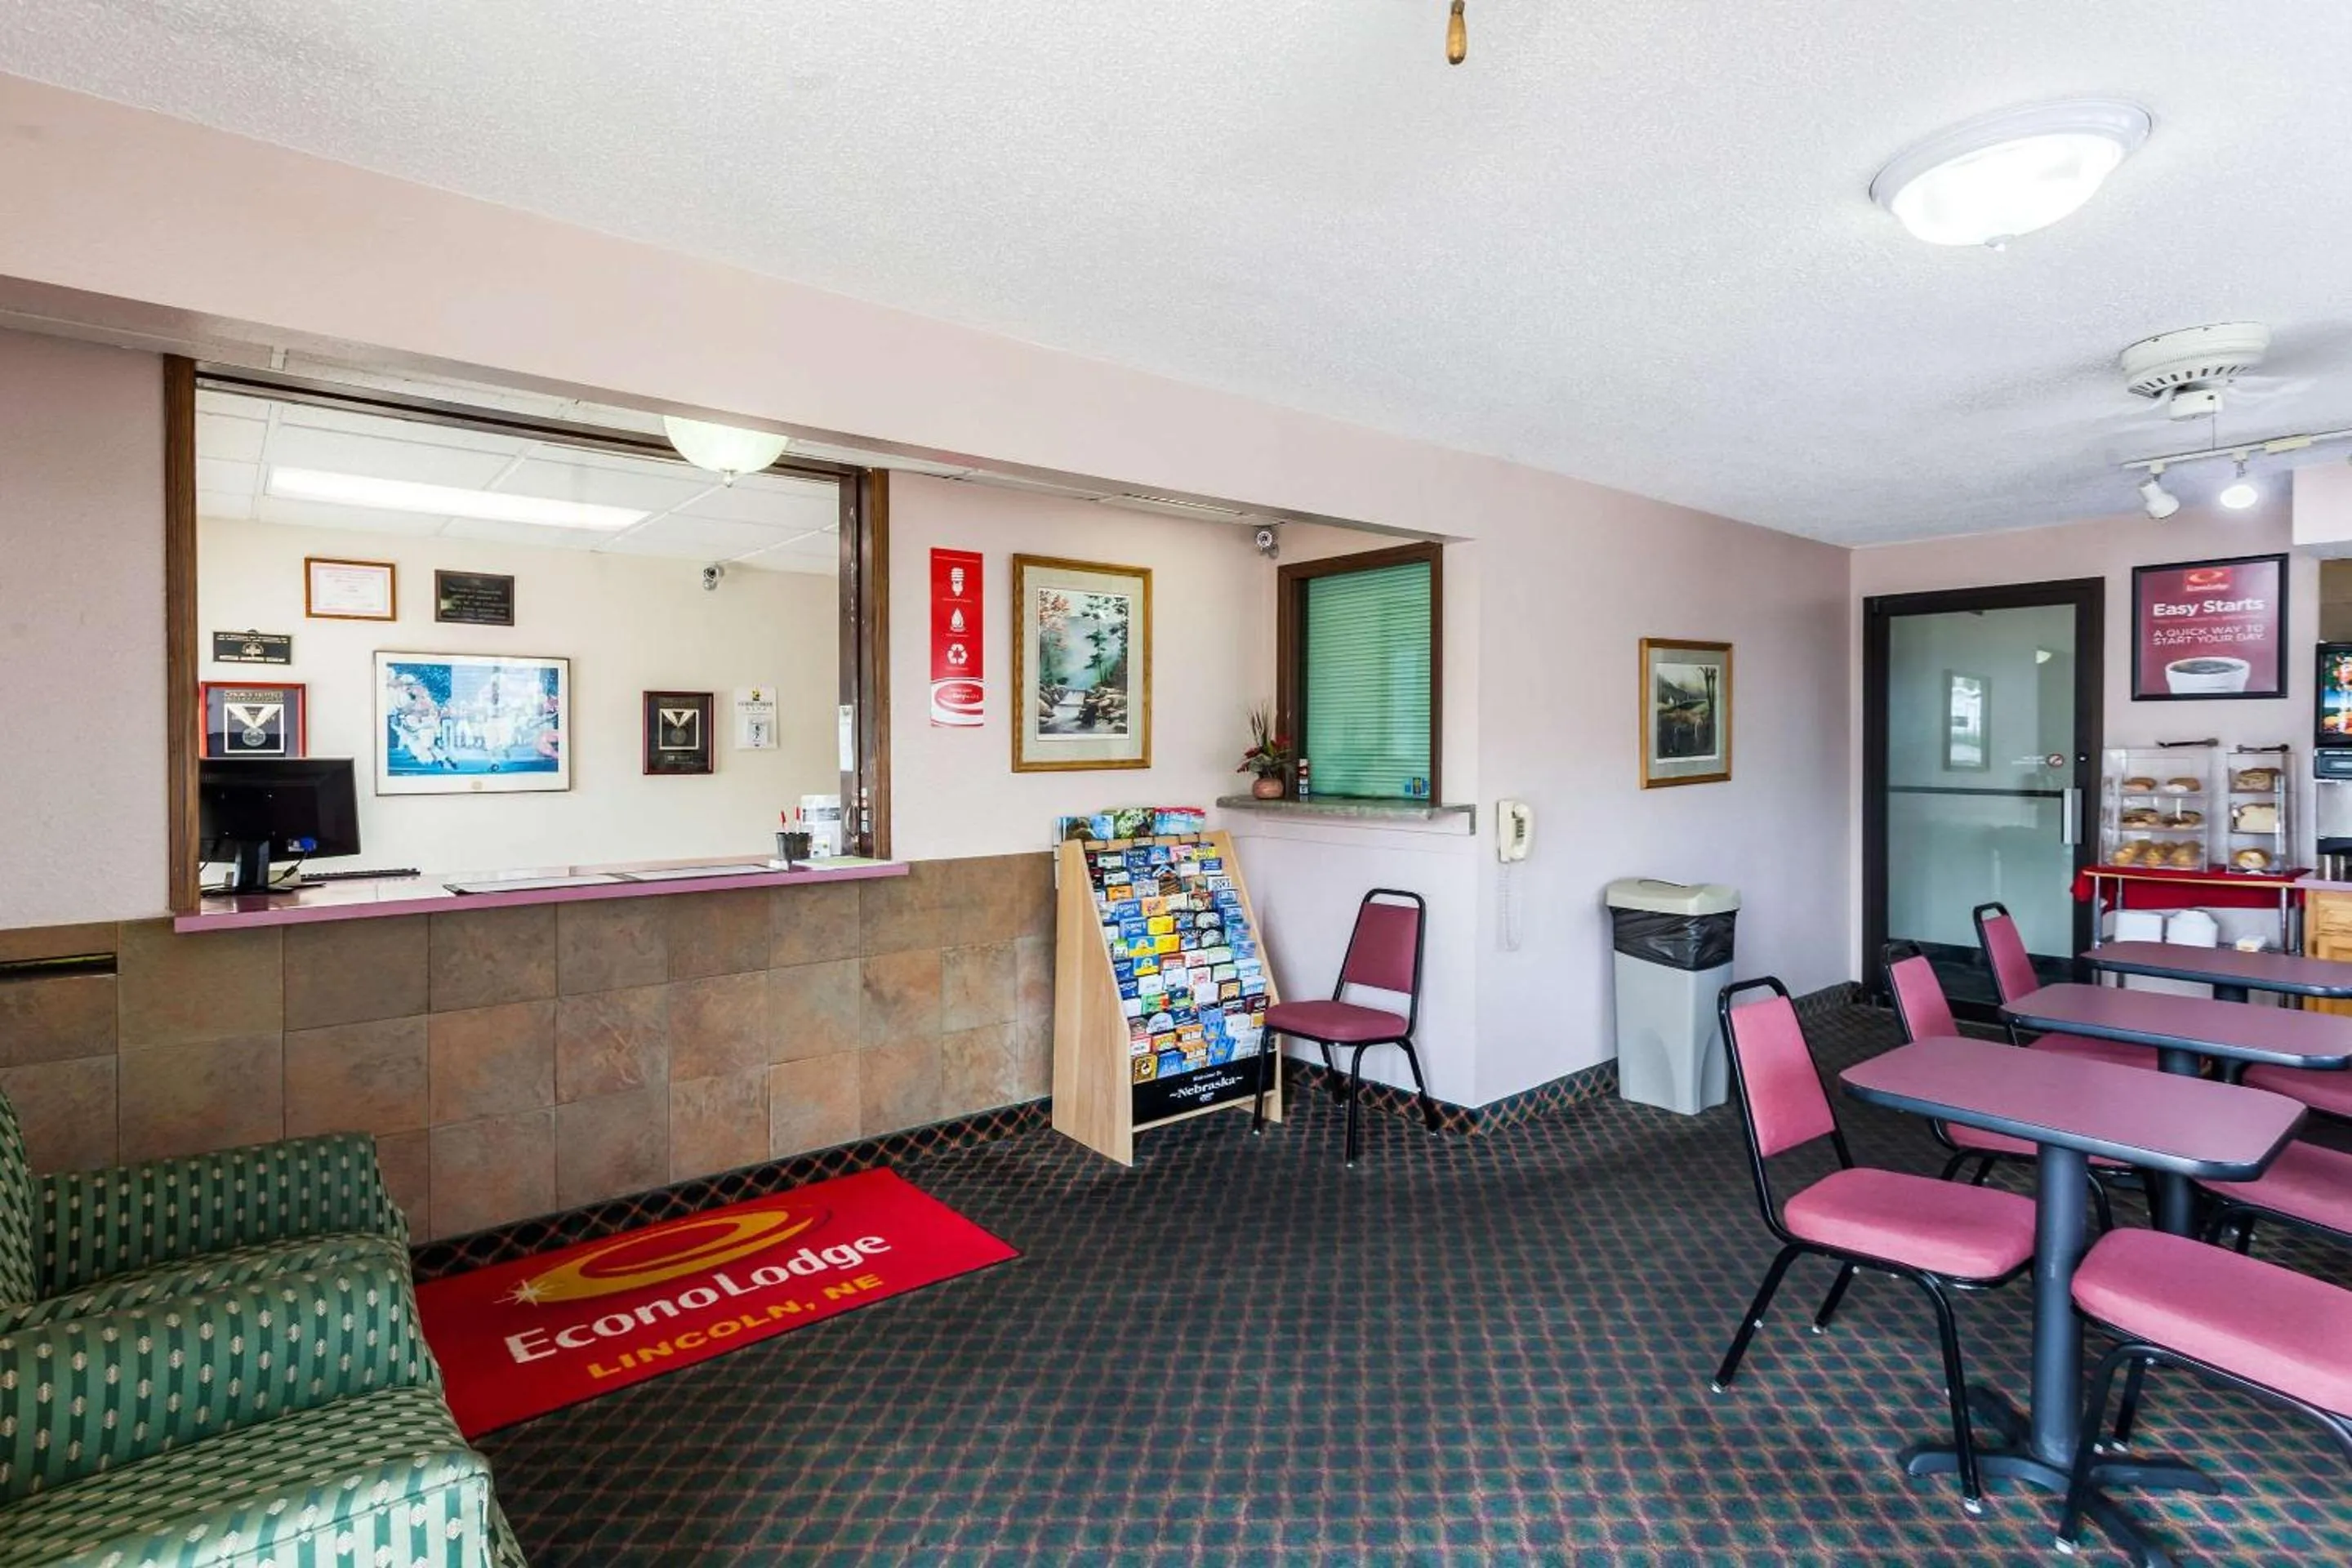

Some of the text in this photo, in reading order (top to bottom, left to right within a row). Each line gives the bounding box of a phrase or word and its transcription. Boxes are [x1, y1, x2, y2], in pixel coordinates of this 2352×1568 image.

[2153, 597, 2265, 617] Easy Starts
[2153, 636, 2194, 645] START
[2197, 635, 2232, 644] YOUR
[2154, 624, 2265, 638] A QUICK WAY TO
[503, 1236, 892, 1364] EconoLodge
[587, 1273, 884, 1379] LINCOLN, NE
